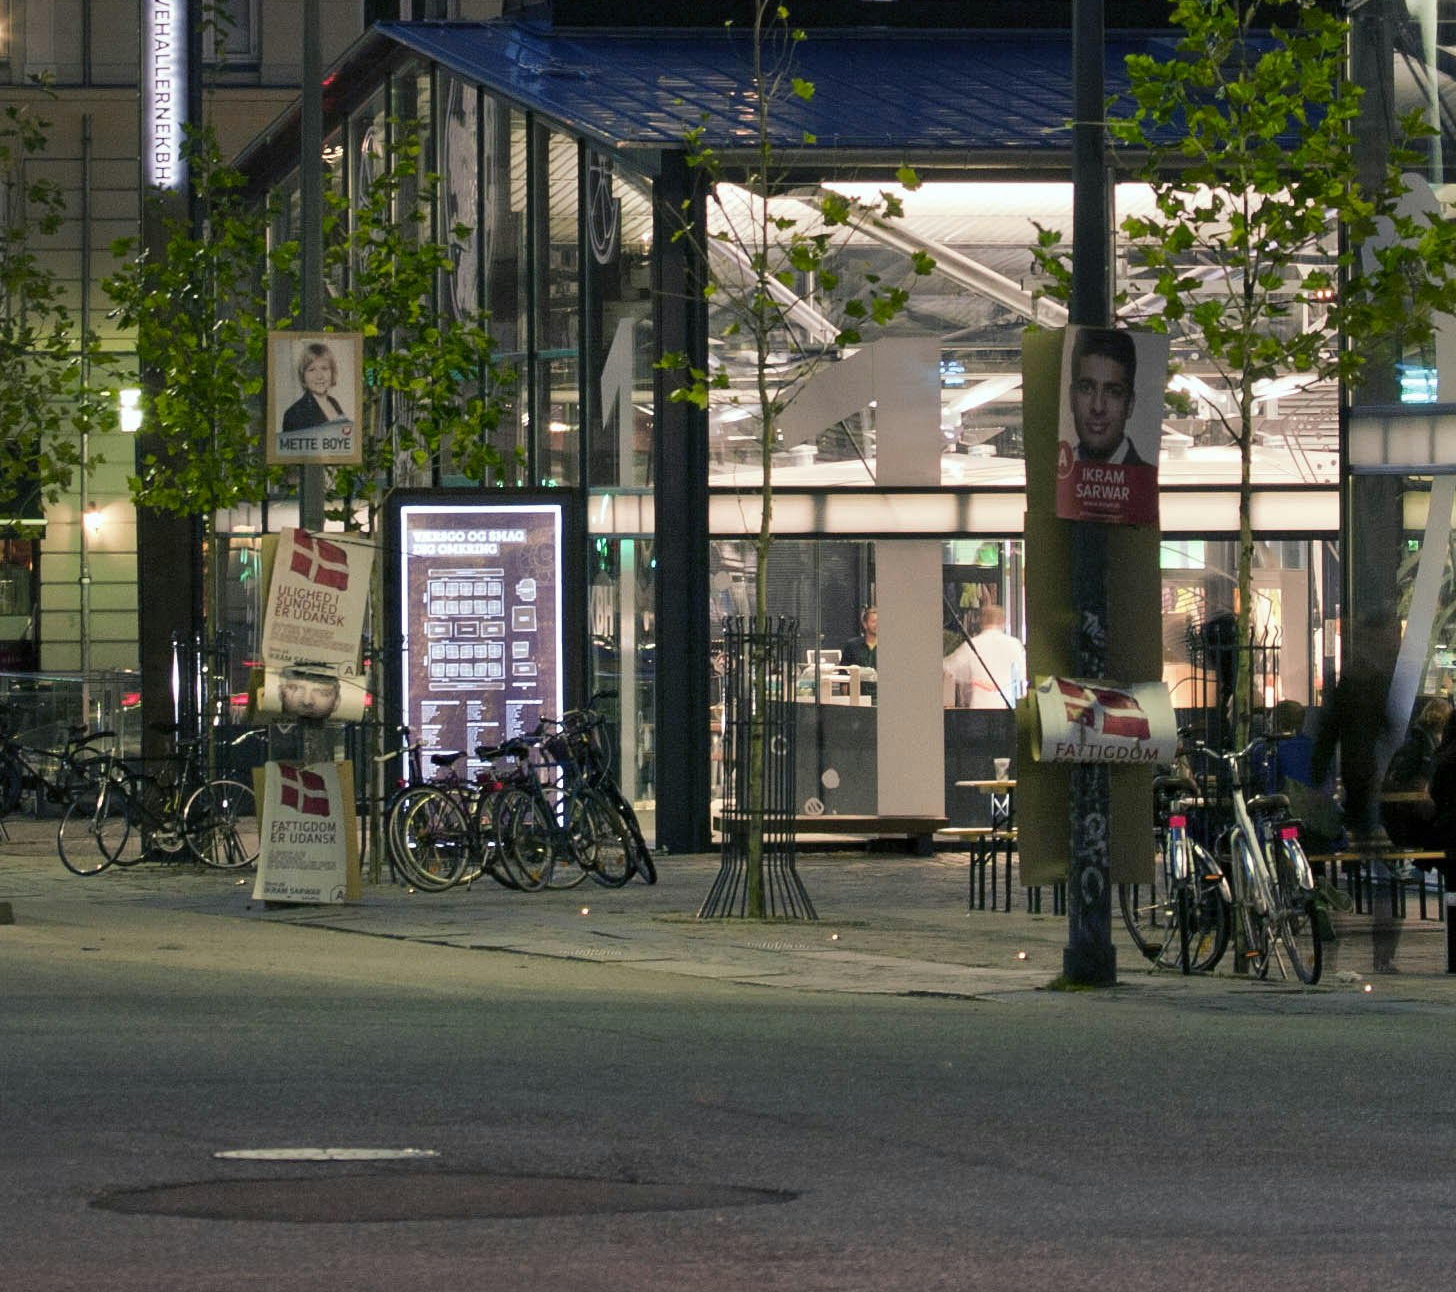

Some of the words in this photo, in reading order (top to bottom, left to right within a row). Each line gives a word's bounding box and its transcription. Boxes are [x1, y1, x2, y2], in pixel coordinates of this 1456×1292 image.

[279, 437, 317, 450] METTE
[322, 437, 351, 450] BOYE
[1057, 448, 1068, 468] A
[1082, 467, 1125, 484] IKRAM
[1075, 483, 1130, 501] SARWAR
[467, 531, 487, 542] OG
[488, 530, 525, 542] SMAG
[437, 543, 498, 555] OMKRING
[278, 584, 332, 603] ULIGHED
[276, 595, 338, 615] SUNDHED
[274, 606, 291, 618] ER
[293, 609, 345, 627] UDANSK
[344, 665, 353, 676] A
[1055, 742, 1159, 761] FATTIGDOM
[271, 820, 337, 833] FATTIGDOM
[270, 832, 286, 843] ER
[289, 832, 337, 844] UDANSK
[335, 890, 344, 900] A
